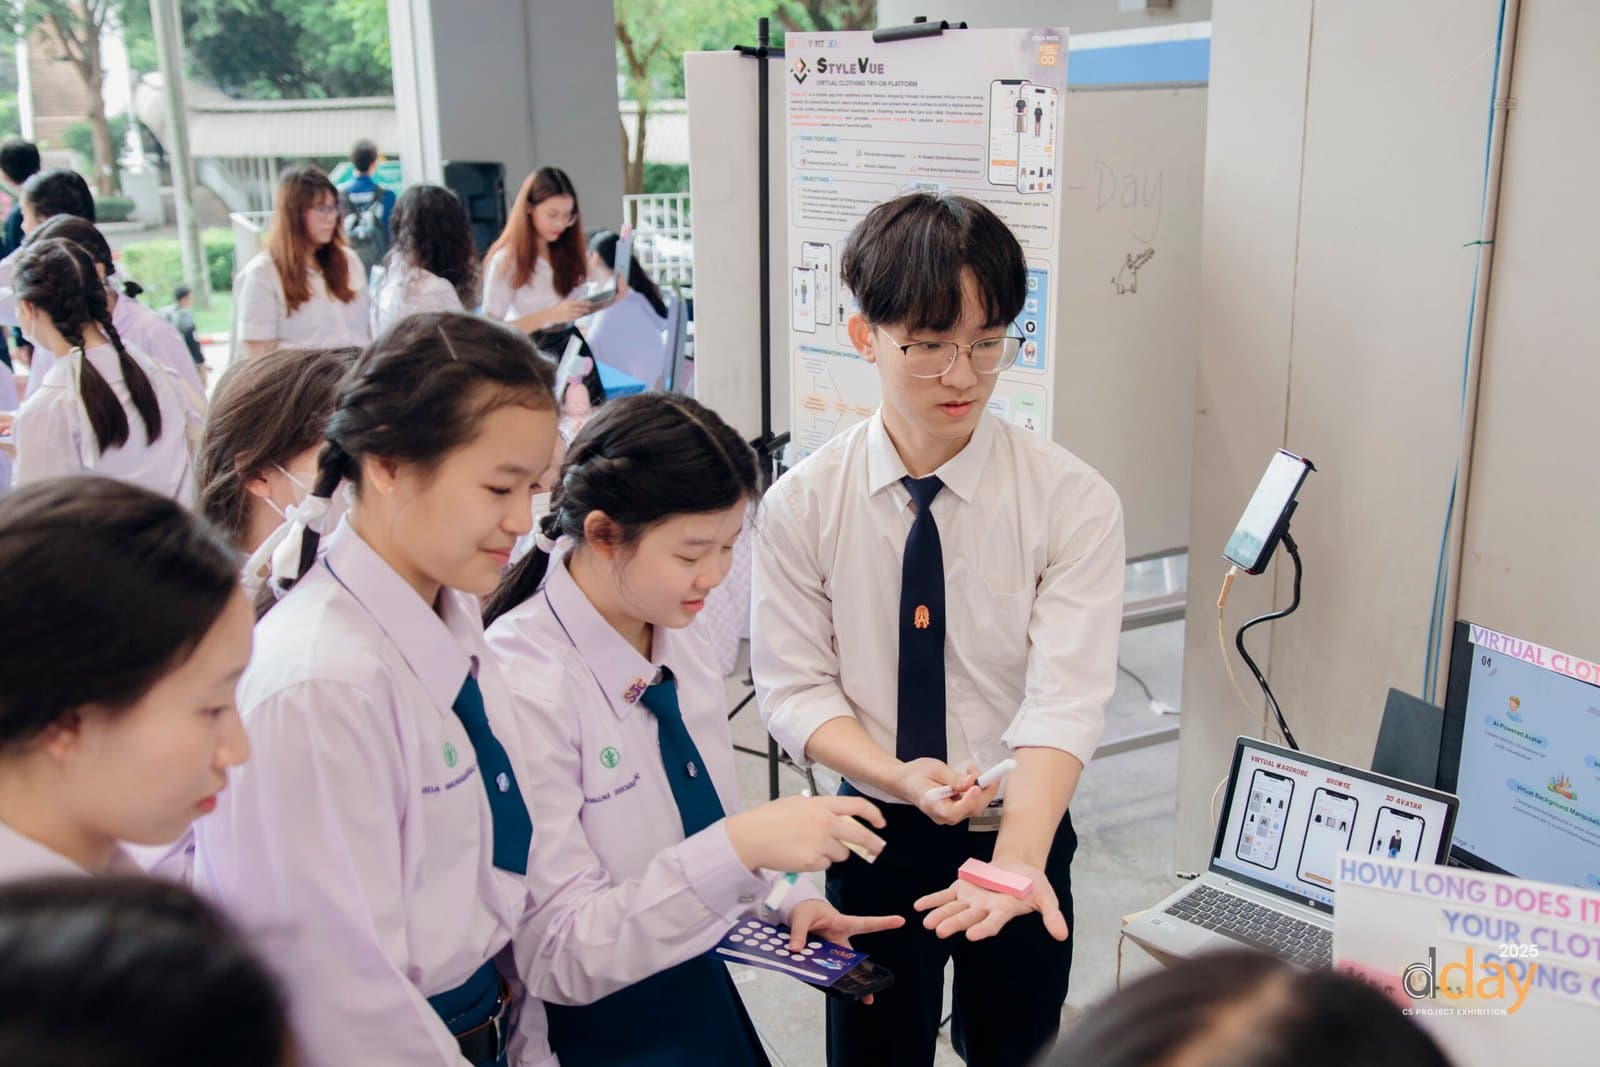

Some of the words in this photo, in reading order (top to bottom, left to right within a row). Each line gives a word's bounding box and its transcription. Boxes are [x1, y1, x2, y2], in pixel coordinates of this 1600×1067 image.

[1471, 625, 1545, 667] VIRTUAL
[1481, 655, 1492, 669] 04
[1250, 755, 1275, 768] VIRTUAL
[1275, 763, 1310, 778] WARDROBE
[1326, 777, 1352, 790] BROWSE
[1385, 794, 1395, 802] 3D
[1395, 798, 1423, 811] AVATAR
[1339, 858, 1404, 889] HOW
[1410, 869, 1487, 904] LONG
[1494, 883, 1572, 919] DOES
[1442, 908, 1521, 945] YOUR
